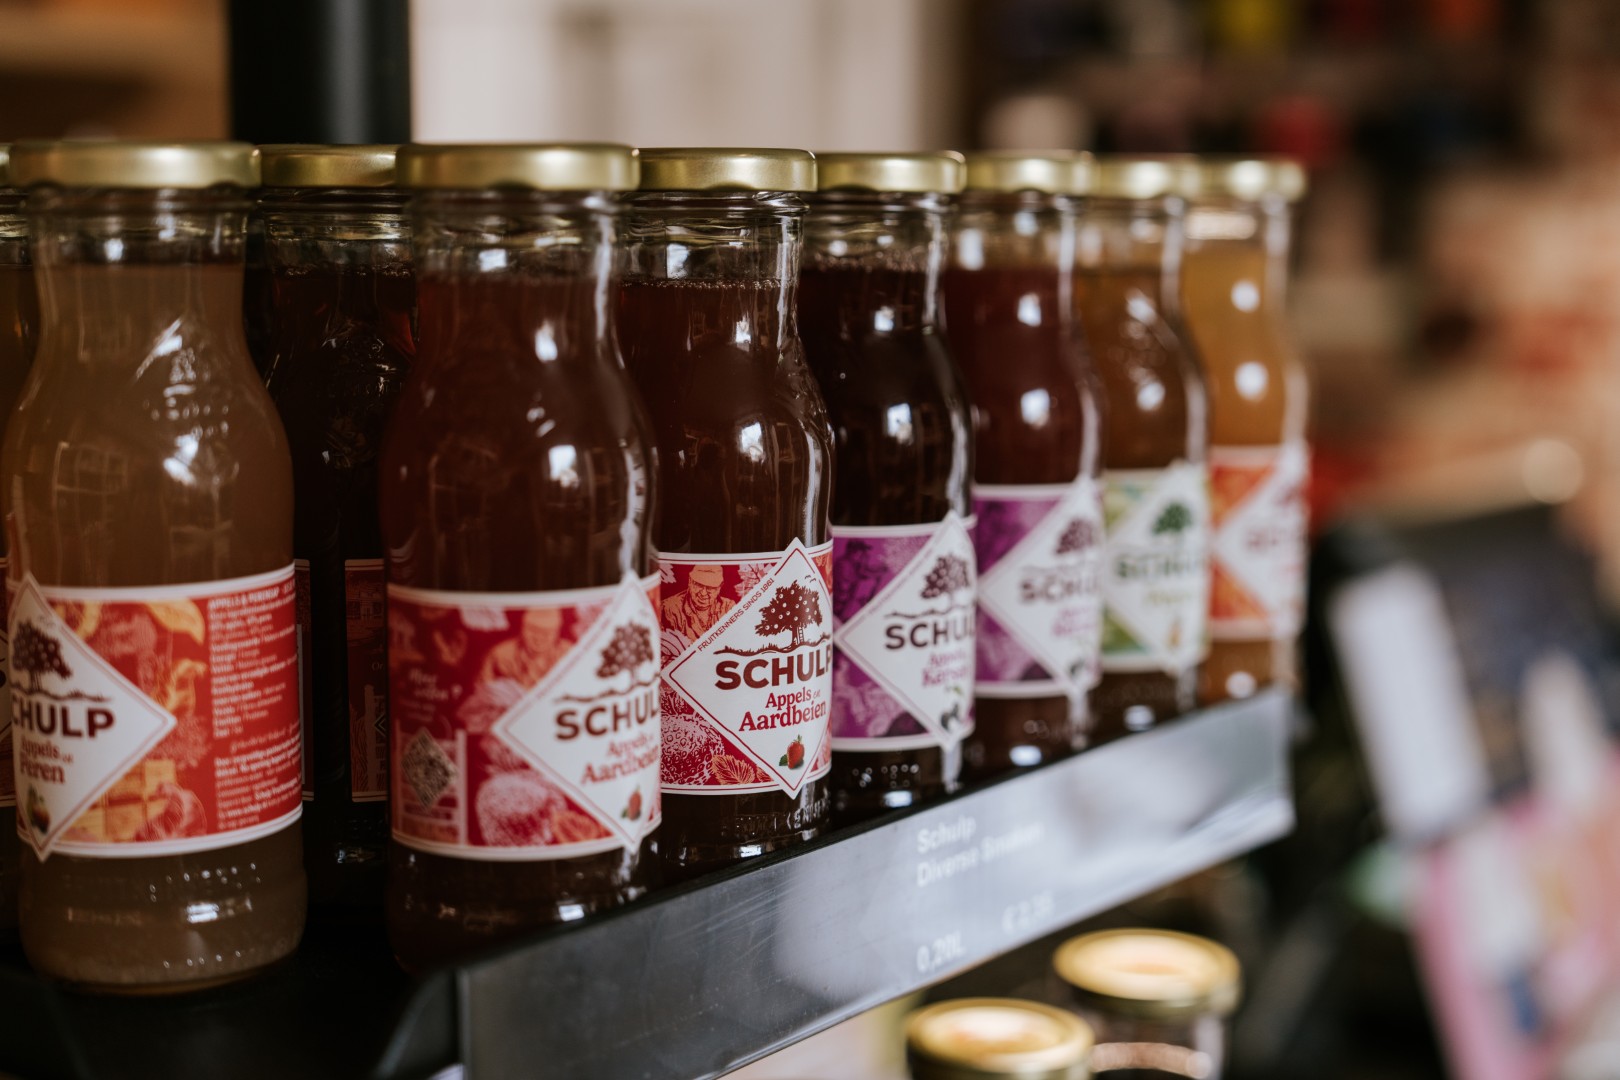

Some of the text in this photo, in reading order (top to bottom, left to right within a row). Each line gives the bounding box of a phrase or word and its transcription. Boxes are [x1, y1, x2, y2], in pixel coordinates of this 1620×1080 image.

[697, 609, 744, 651] FRUITKENNERS
[743, 591, 762, 611] SINDS
[738, 700, 827, 732] Aardbeien
[765, 686, 811, 711] Appels
[917, 815, 976, 854] Schulp
